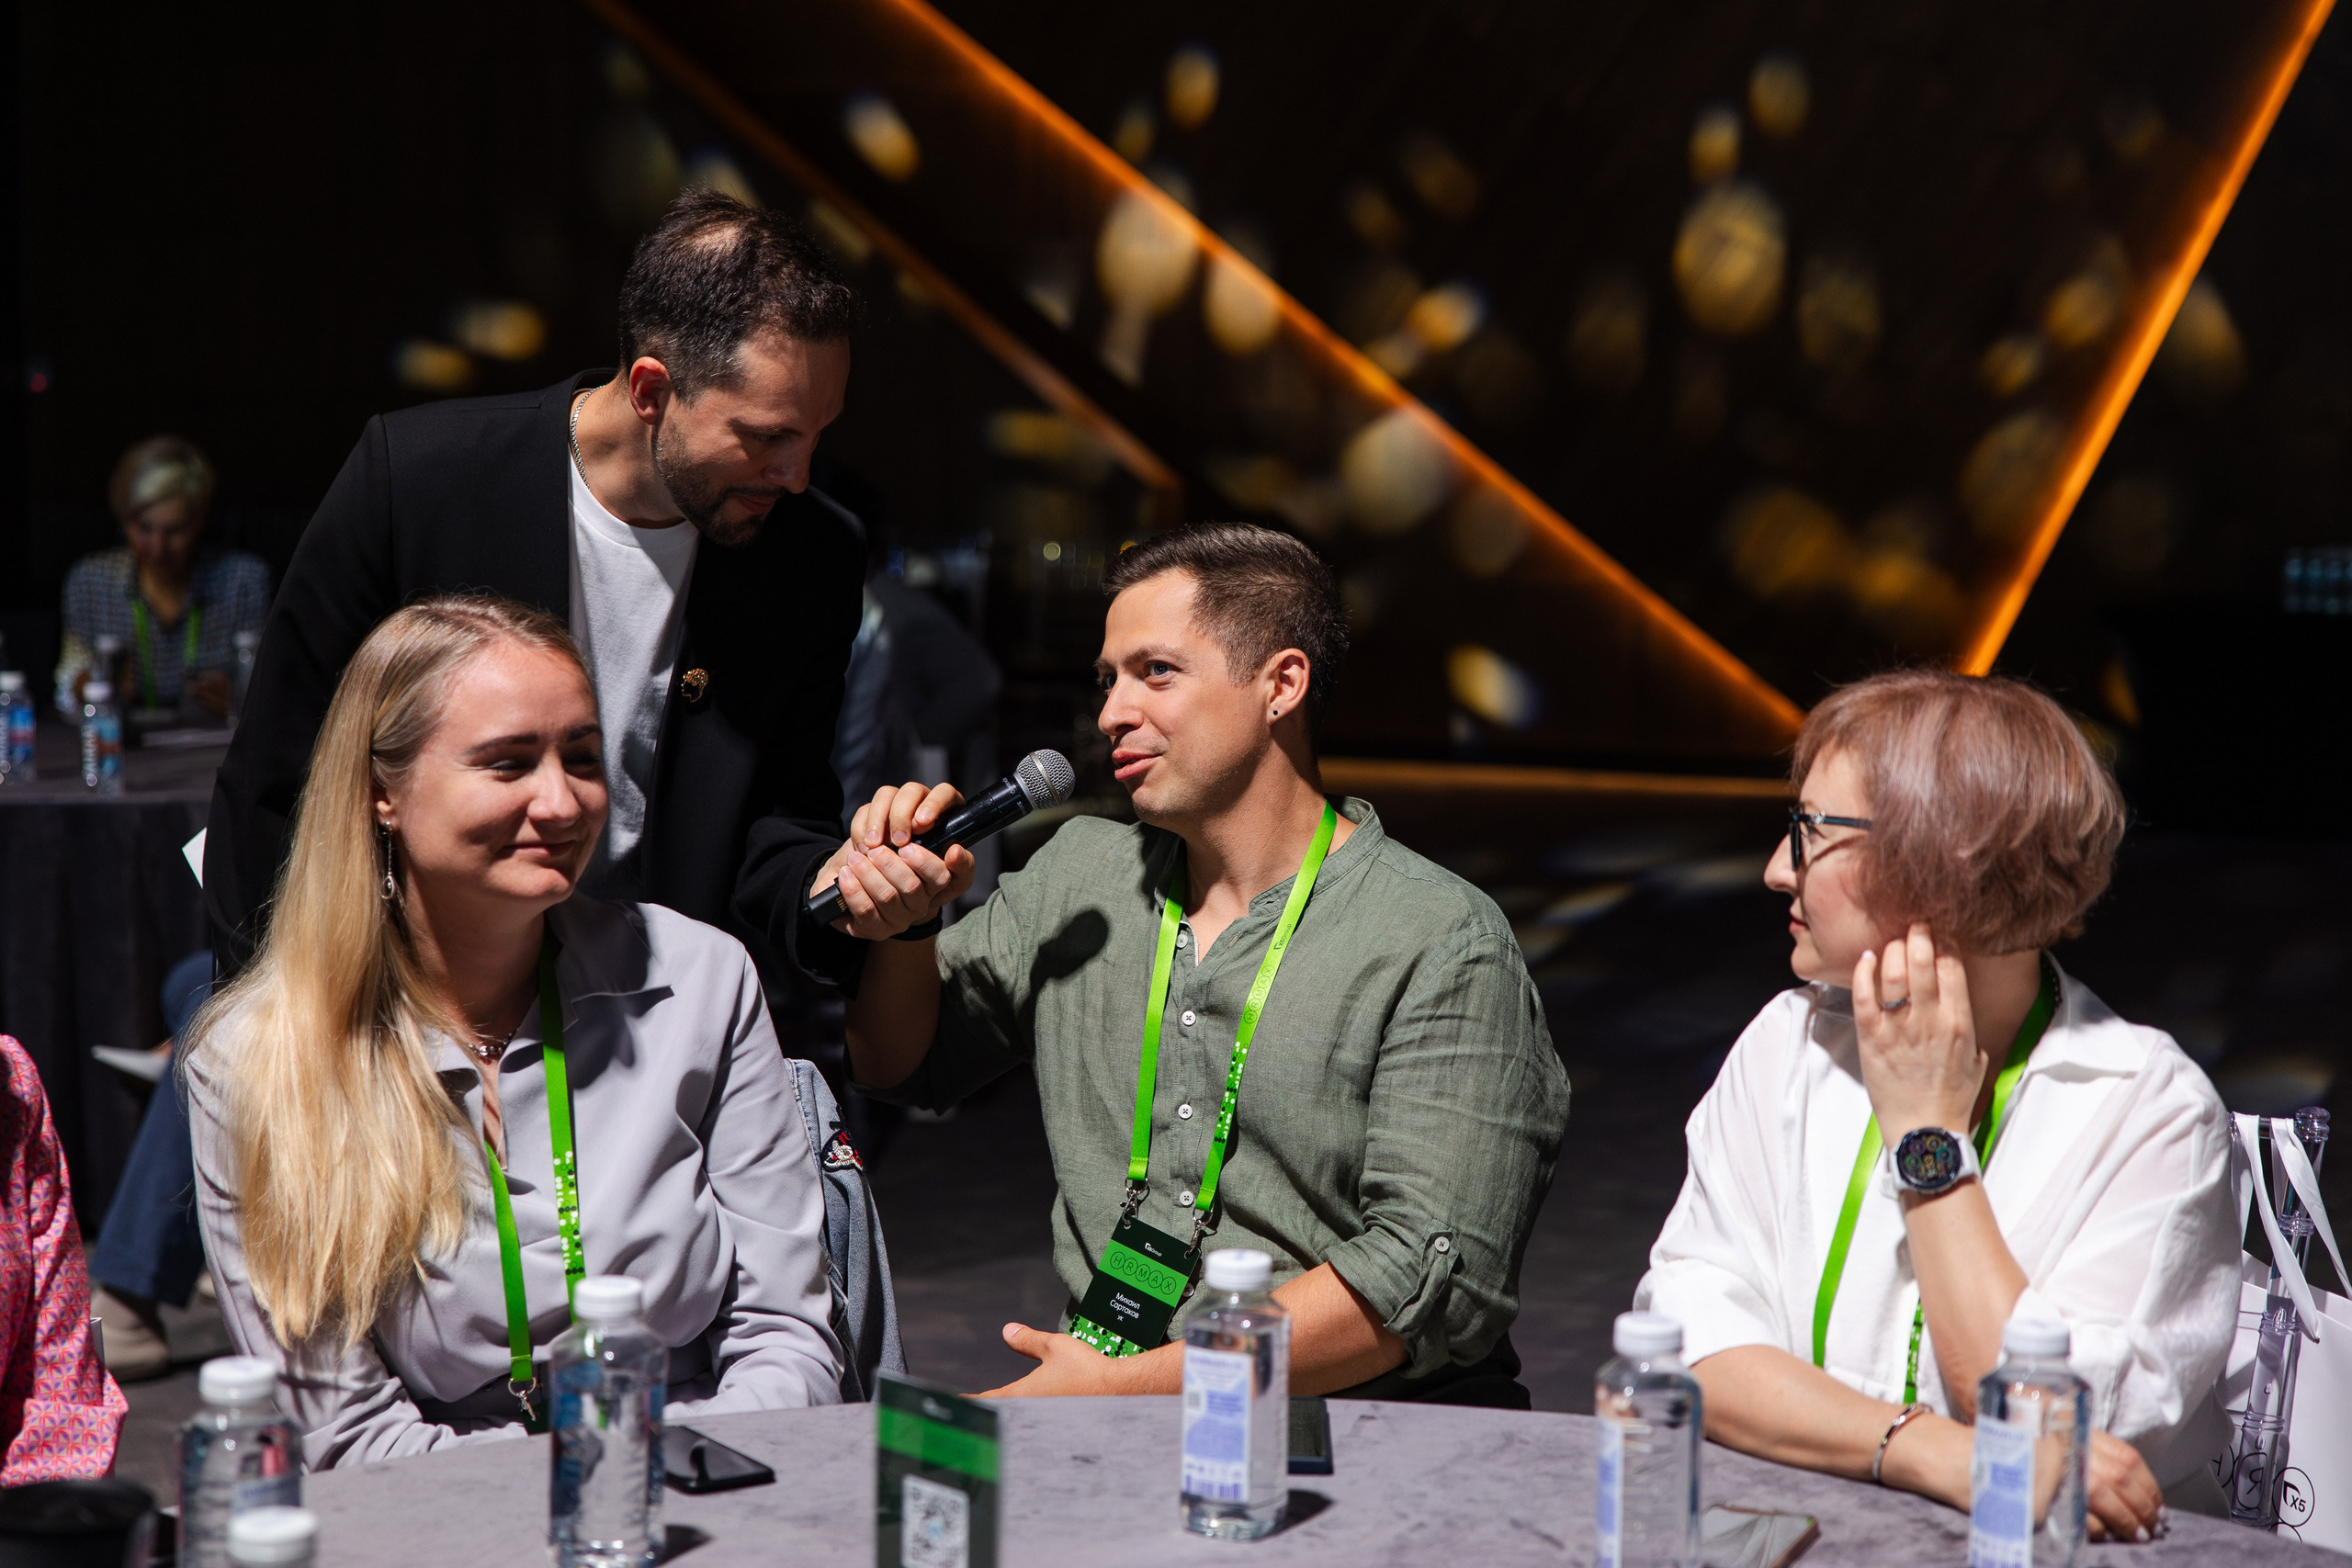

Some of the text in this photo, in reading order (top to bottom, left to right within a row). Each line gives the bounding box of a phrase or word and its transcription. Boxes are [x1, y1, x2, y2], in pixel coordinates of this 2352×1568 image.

[1247, 967, 1272, 1021] HRMAX
[1113, 1255, 1173, 1291] HRMAX
[1115, 1292, 1140, 1310] Михаил
[2290, 1495, 2306, 1513] X5
